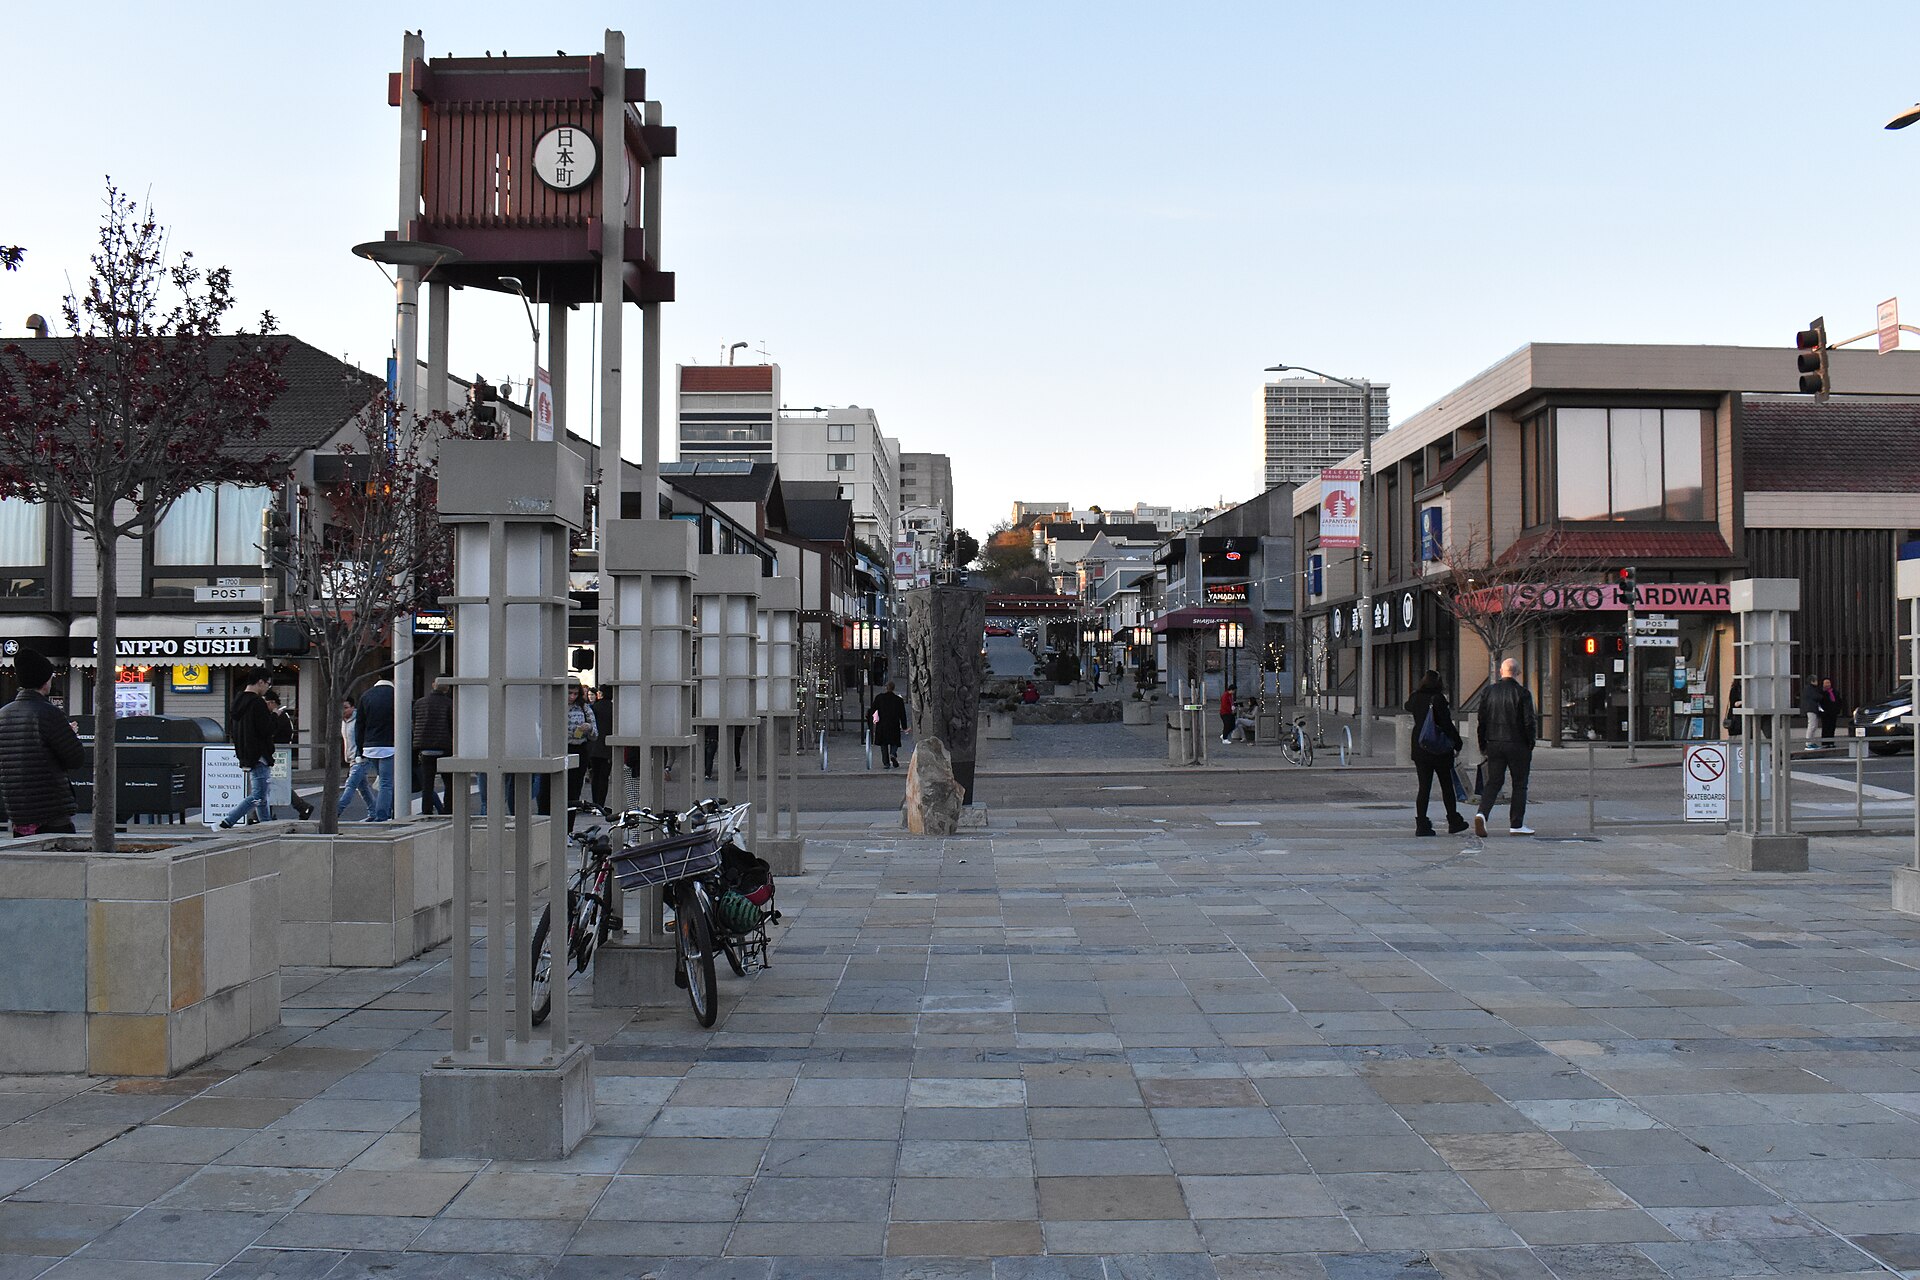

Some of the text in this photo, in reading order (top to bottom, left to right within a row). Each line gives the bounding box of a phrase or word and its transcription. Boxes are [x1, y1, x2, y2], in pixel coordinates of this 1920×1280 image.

[555, 129, 575, 187] 日本町
[211, 589, 246, 598] POST
[1519, 586, 1604, 610] SOKO
[93, 639, 250, 655] NPPO SUSHI
[1686, 793, 1726, 801] SKATEBOARDS
